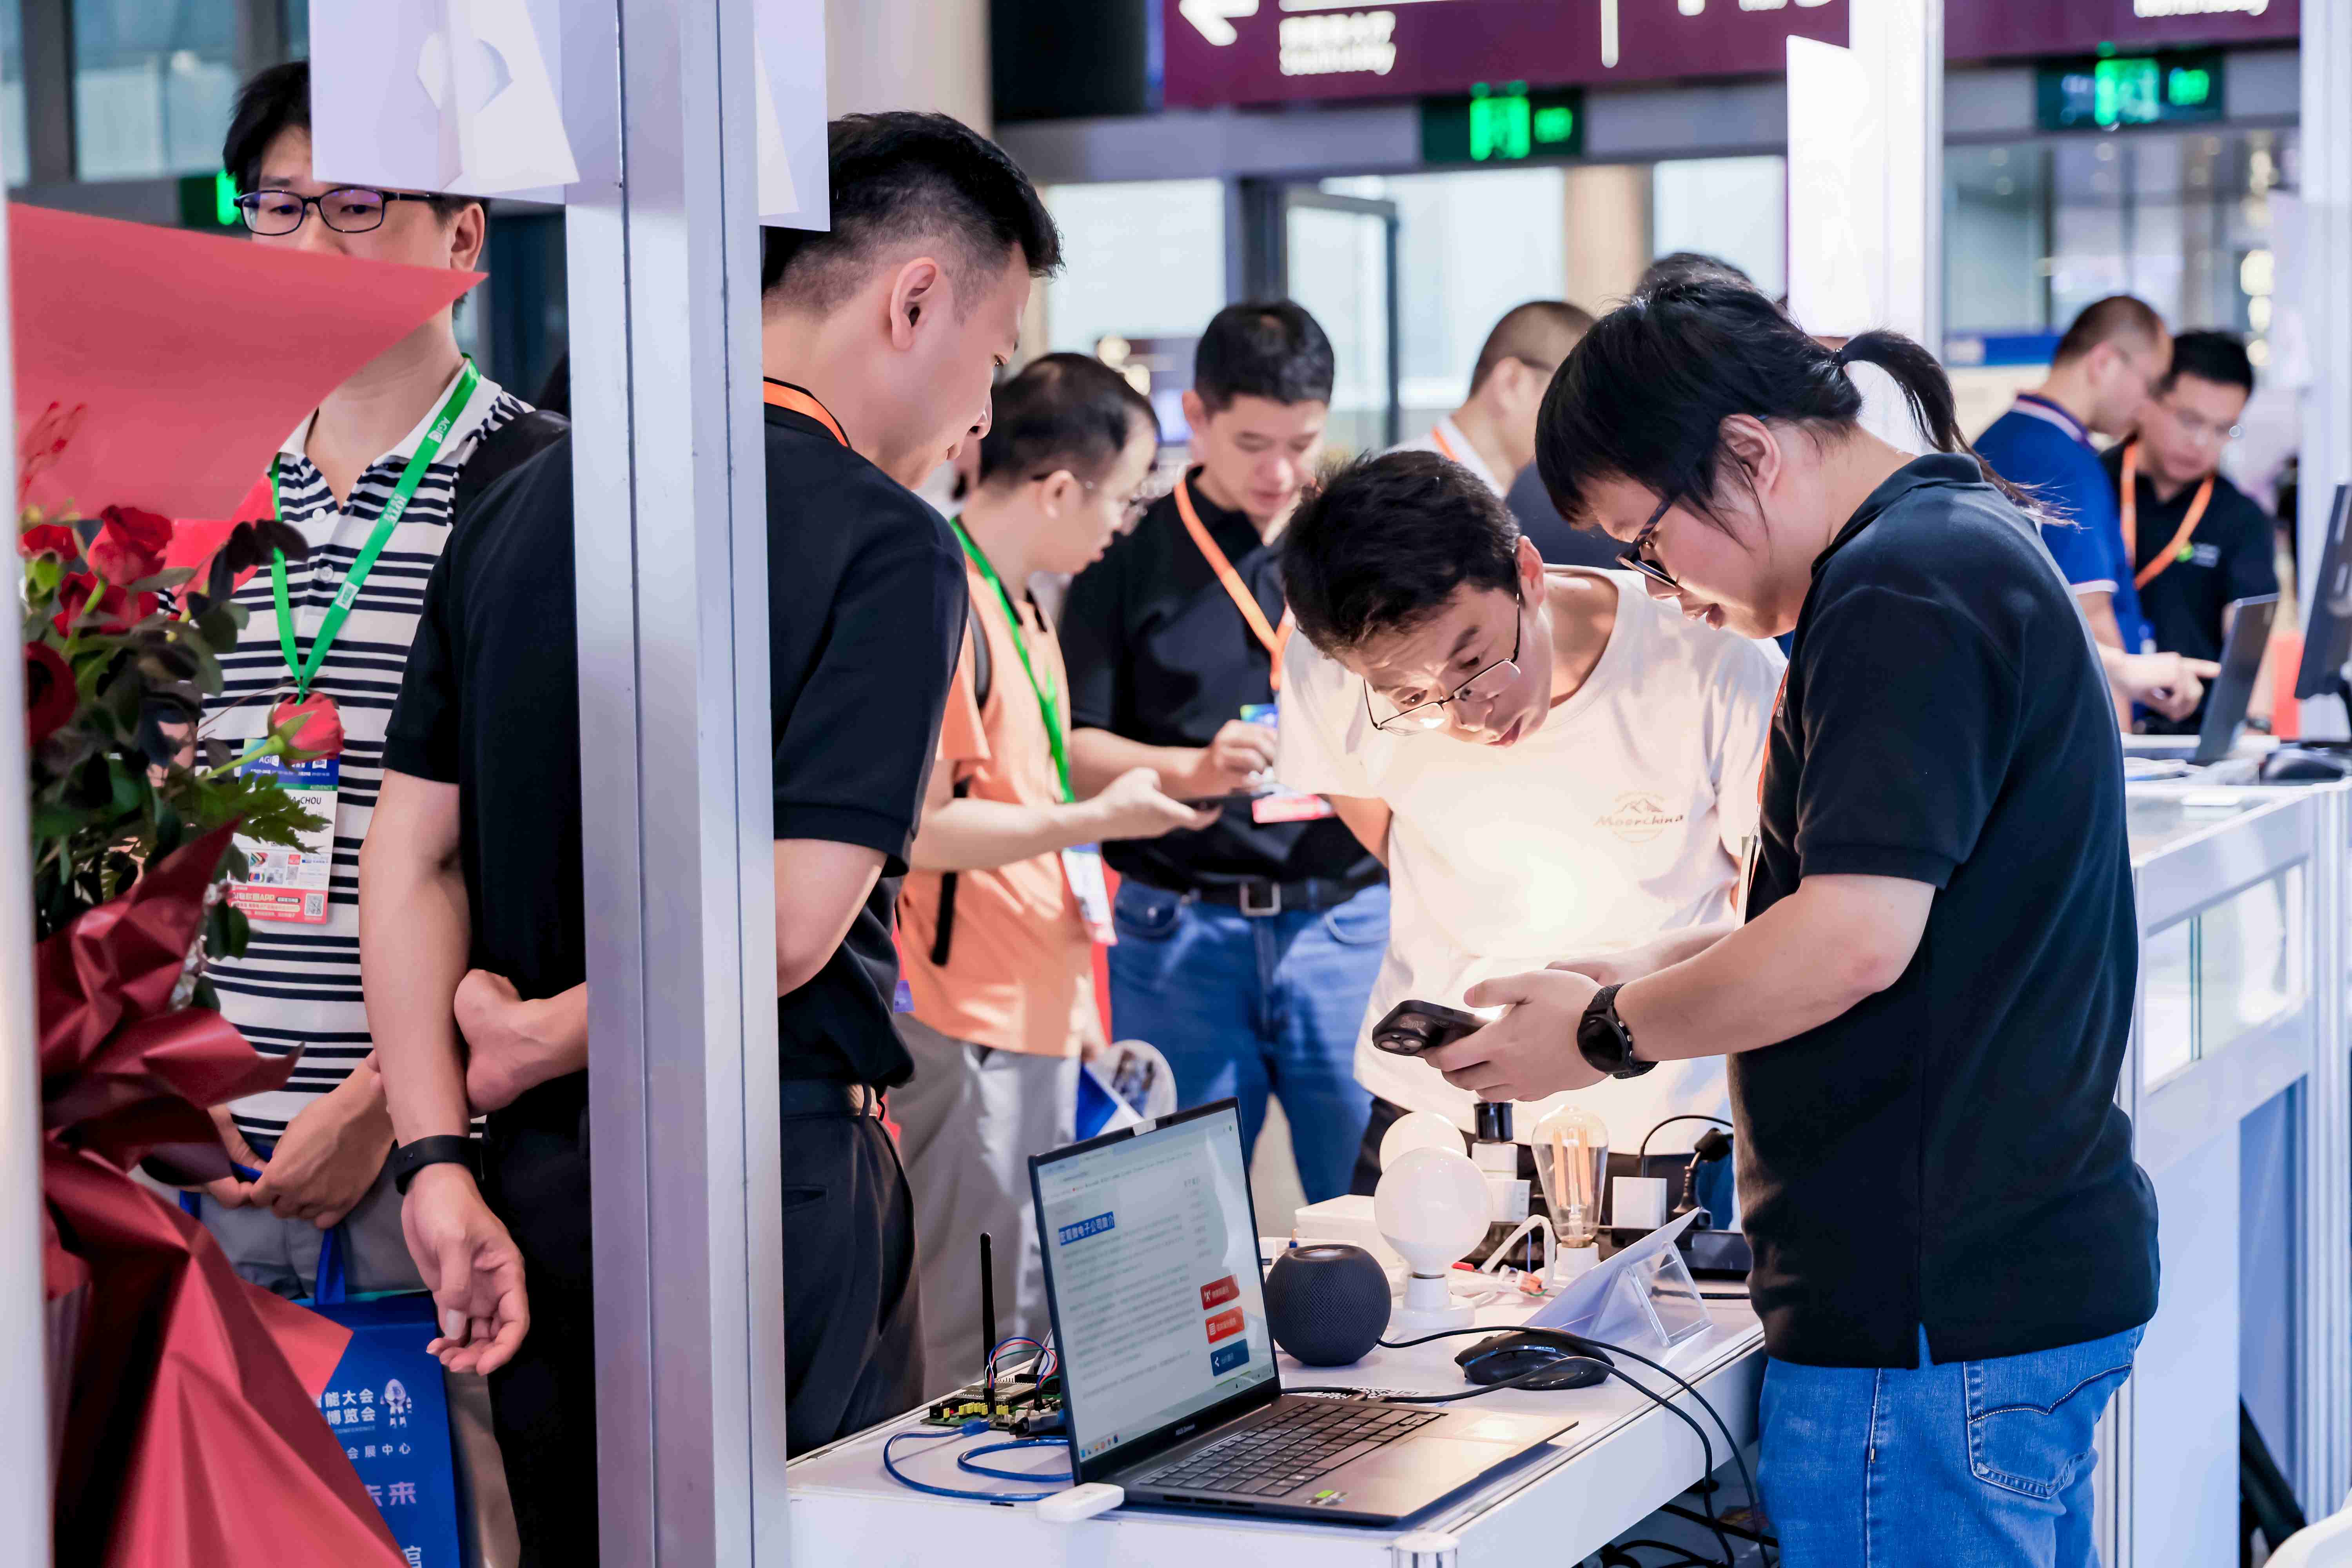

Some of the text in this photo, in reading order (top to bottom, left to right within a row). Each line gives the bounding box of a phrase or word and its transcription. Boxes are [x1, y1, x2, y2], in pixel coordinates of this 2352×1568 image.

[317, 1388, 374, 1408] 能大会
[347, 1443, 411, 1459] 会展中心
